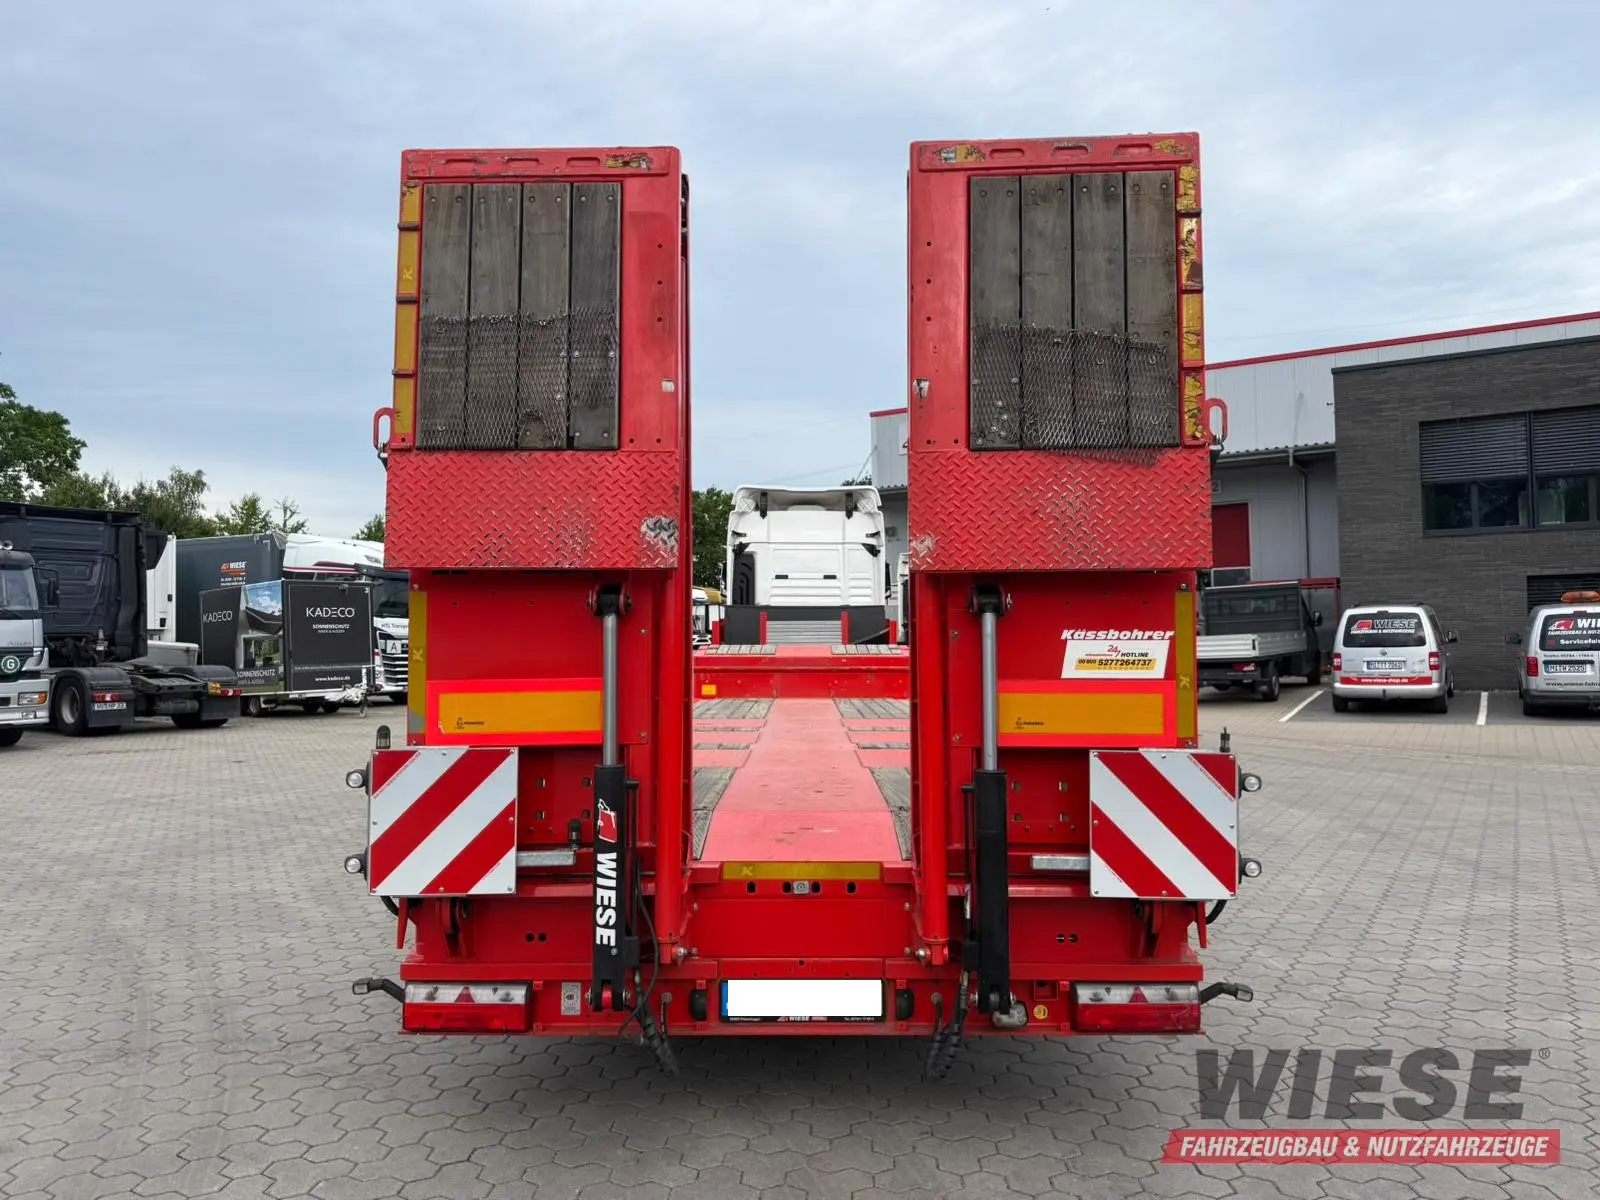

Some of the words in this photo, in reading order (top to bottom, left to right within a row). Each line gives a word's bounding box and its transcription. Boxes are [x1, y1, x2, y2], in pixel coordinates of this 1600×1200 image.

[203, 610, 233, 623] KADECO
[305, 607, 355, 618] KADECO
[1374, 619, 1417, 628] WIESE
[1060, 629, 1176, 640] Kässbohrer
[390, 642, 398, 653] A
[7, 659, 15, 669] G
[1098, 659, 1152, 667] 5277264737
[236, 669, 276, 678] SONNENSCHUTZ
[595, 851, 617, 947] WIESE
